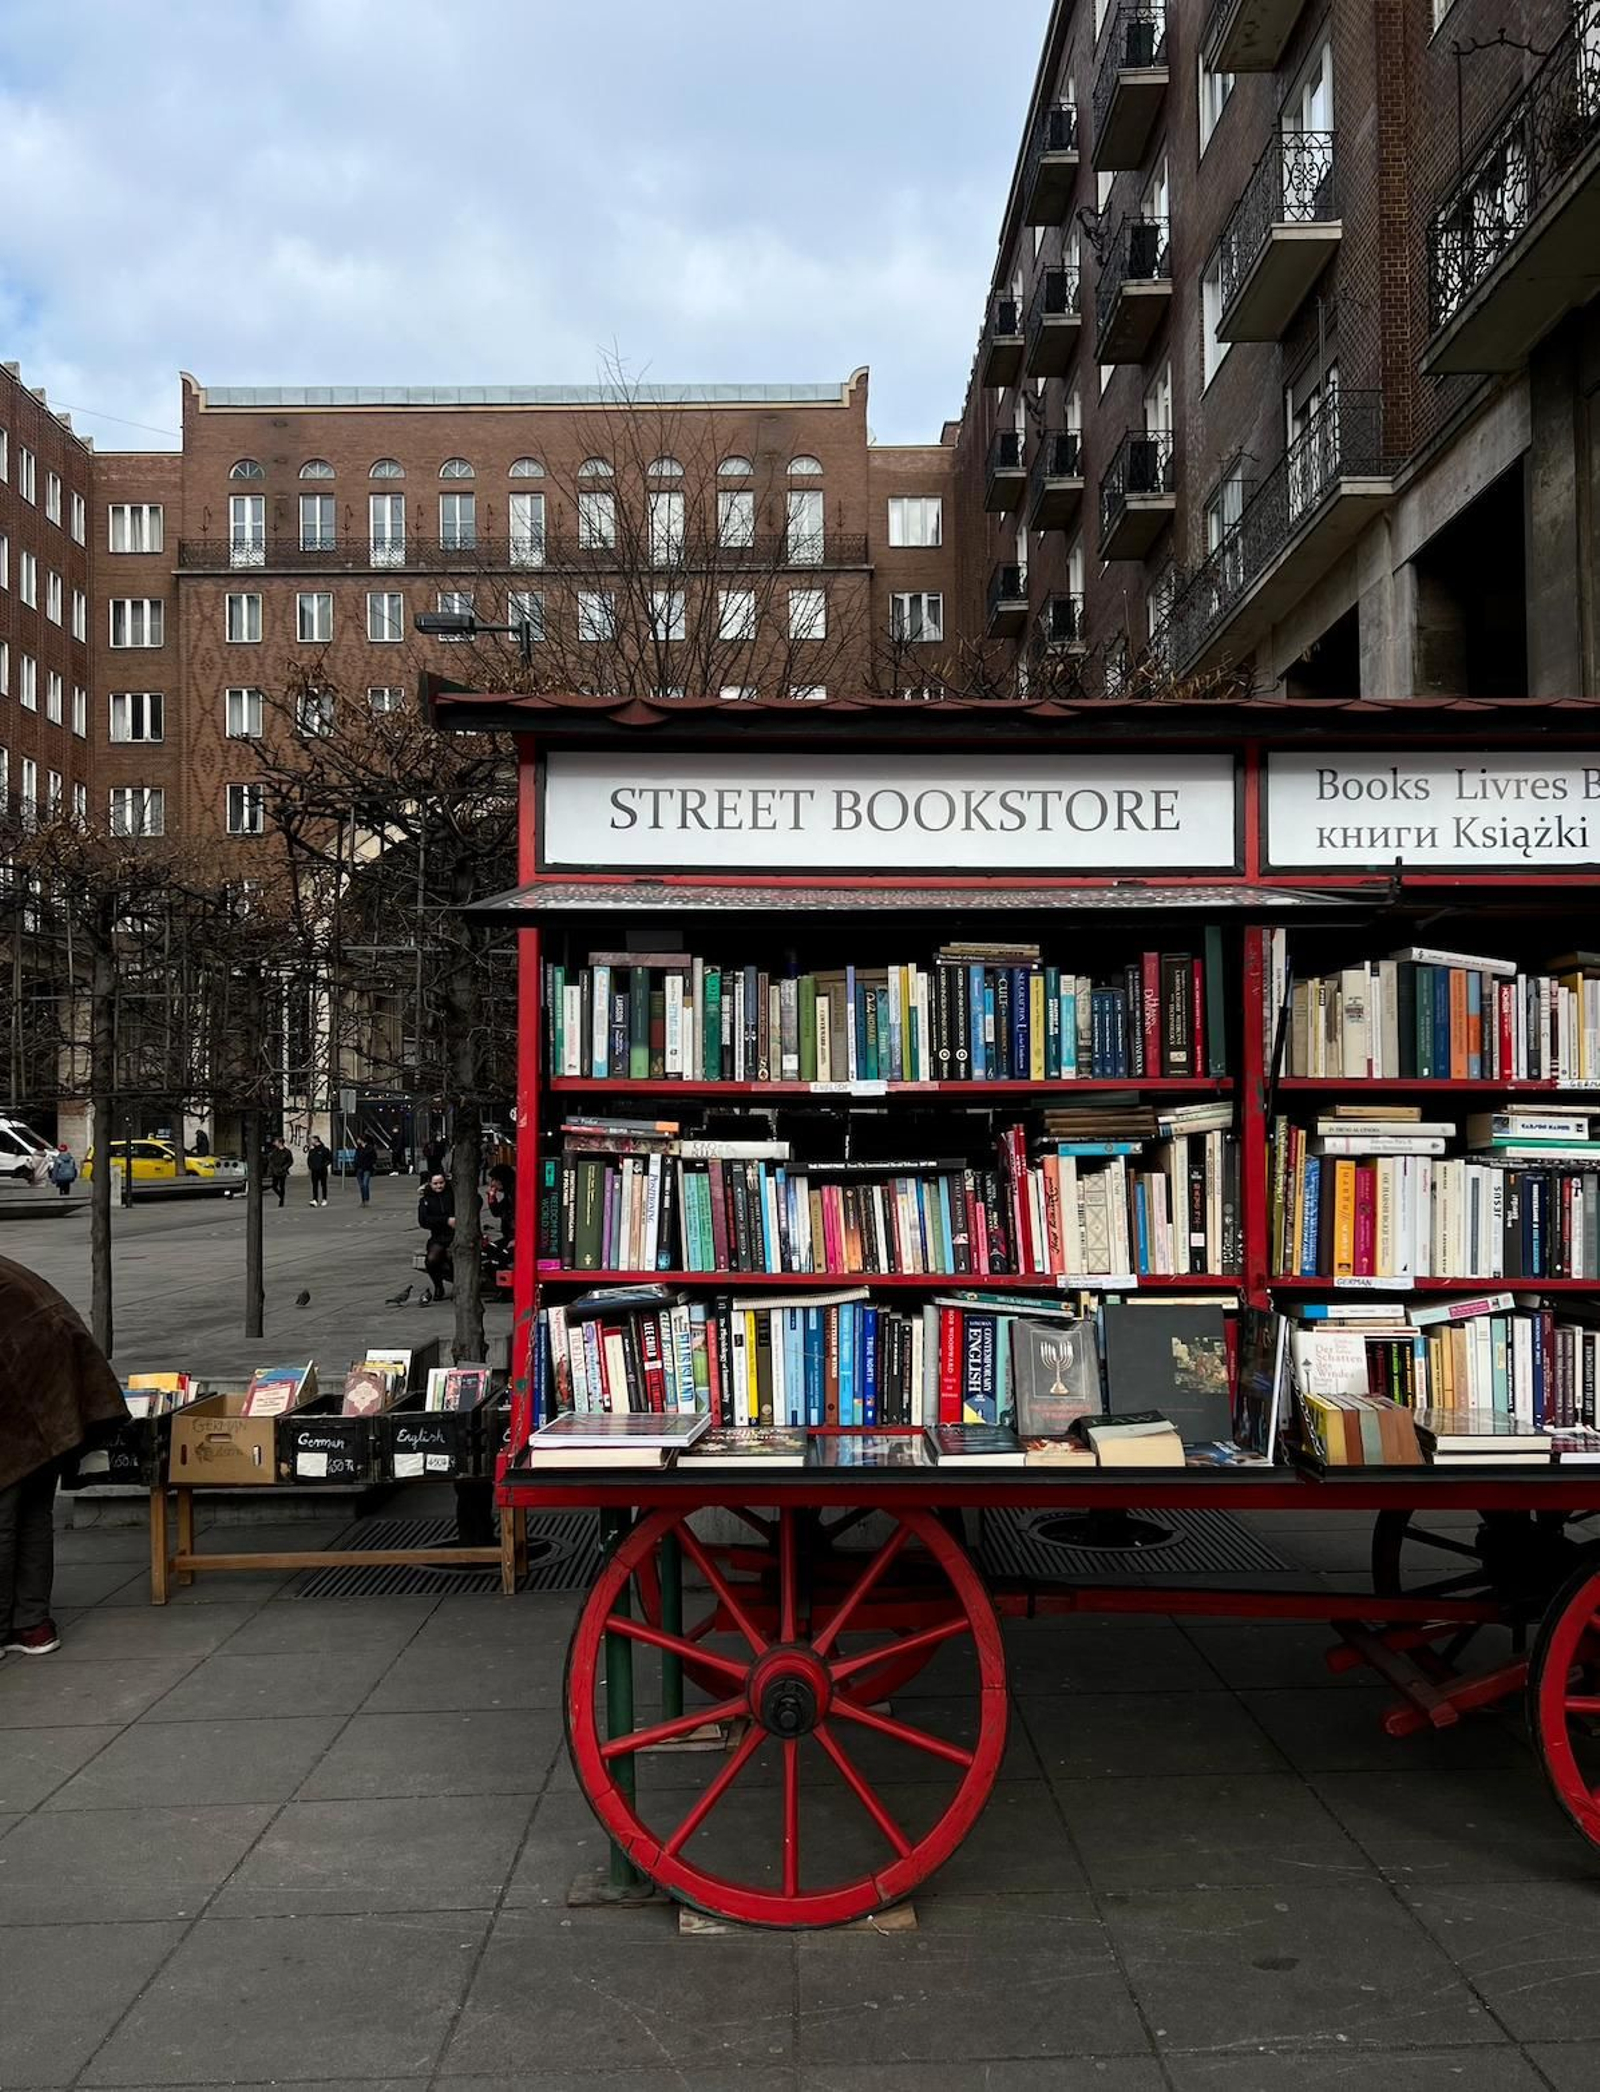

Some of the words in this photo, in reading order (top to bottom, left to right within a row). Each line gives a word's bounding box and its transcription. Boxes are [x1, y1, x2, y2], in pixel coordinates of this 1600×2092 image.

[1315, 766, 1431, 801] Books
[1455, 768, 1568, 800] Livres
[611, 787, 814, 831] STREET
[832, 788, 1181, 832] BOOKSTORE
[1316, 826, 1439, 848] книги
[1453, 814, 1590, 858] Książki
[998, 978, 1008, 1006] CULT
[615, 994, 624, 1024] LARSSON
[647, 1173, 659, 1224] POSITIONING
[1493, 1186, 1502, 1219] JESUS
[956, 1201, 964, 1229] BOUND
[1336, 1278, 1373, 1286] GERMAN
[643, 1321, 654, 1335] LEE
[659, 1311, 671, 1341] CLEAN
[646, 1335, 657, 1358] CHILD
[661, 1342, 674, 1374] SWEEP
[675, 1333, 691, 1364] ELLIS
[719, 1328, 730, 1363] Physiology
[866, 1336, 874, 1356] TRUE
[947, 1326, 955, 1374] WOODWARD
[968, 1327, 982, 1392] ENGLISH
[983, 1327, 993, 1392] CONTEMPORARY
[1315, 1344, 1333, 1353] Der
[1315, 1353, 1363, 1363] Schatten
[866, 1356, 874, 1383] NORTH
[1316, 1360, 1333, 1369] des
[1317, 1368, 1355, 1378] Windes
[677, 1363, 694, 1402] ISLAND
[1585, 1382, 1593, 1391] LA
[298, 1432, 345, 1450] German
[396, 1427, 446, 1450] English
